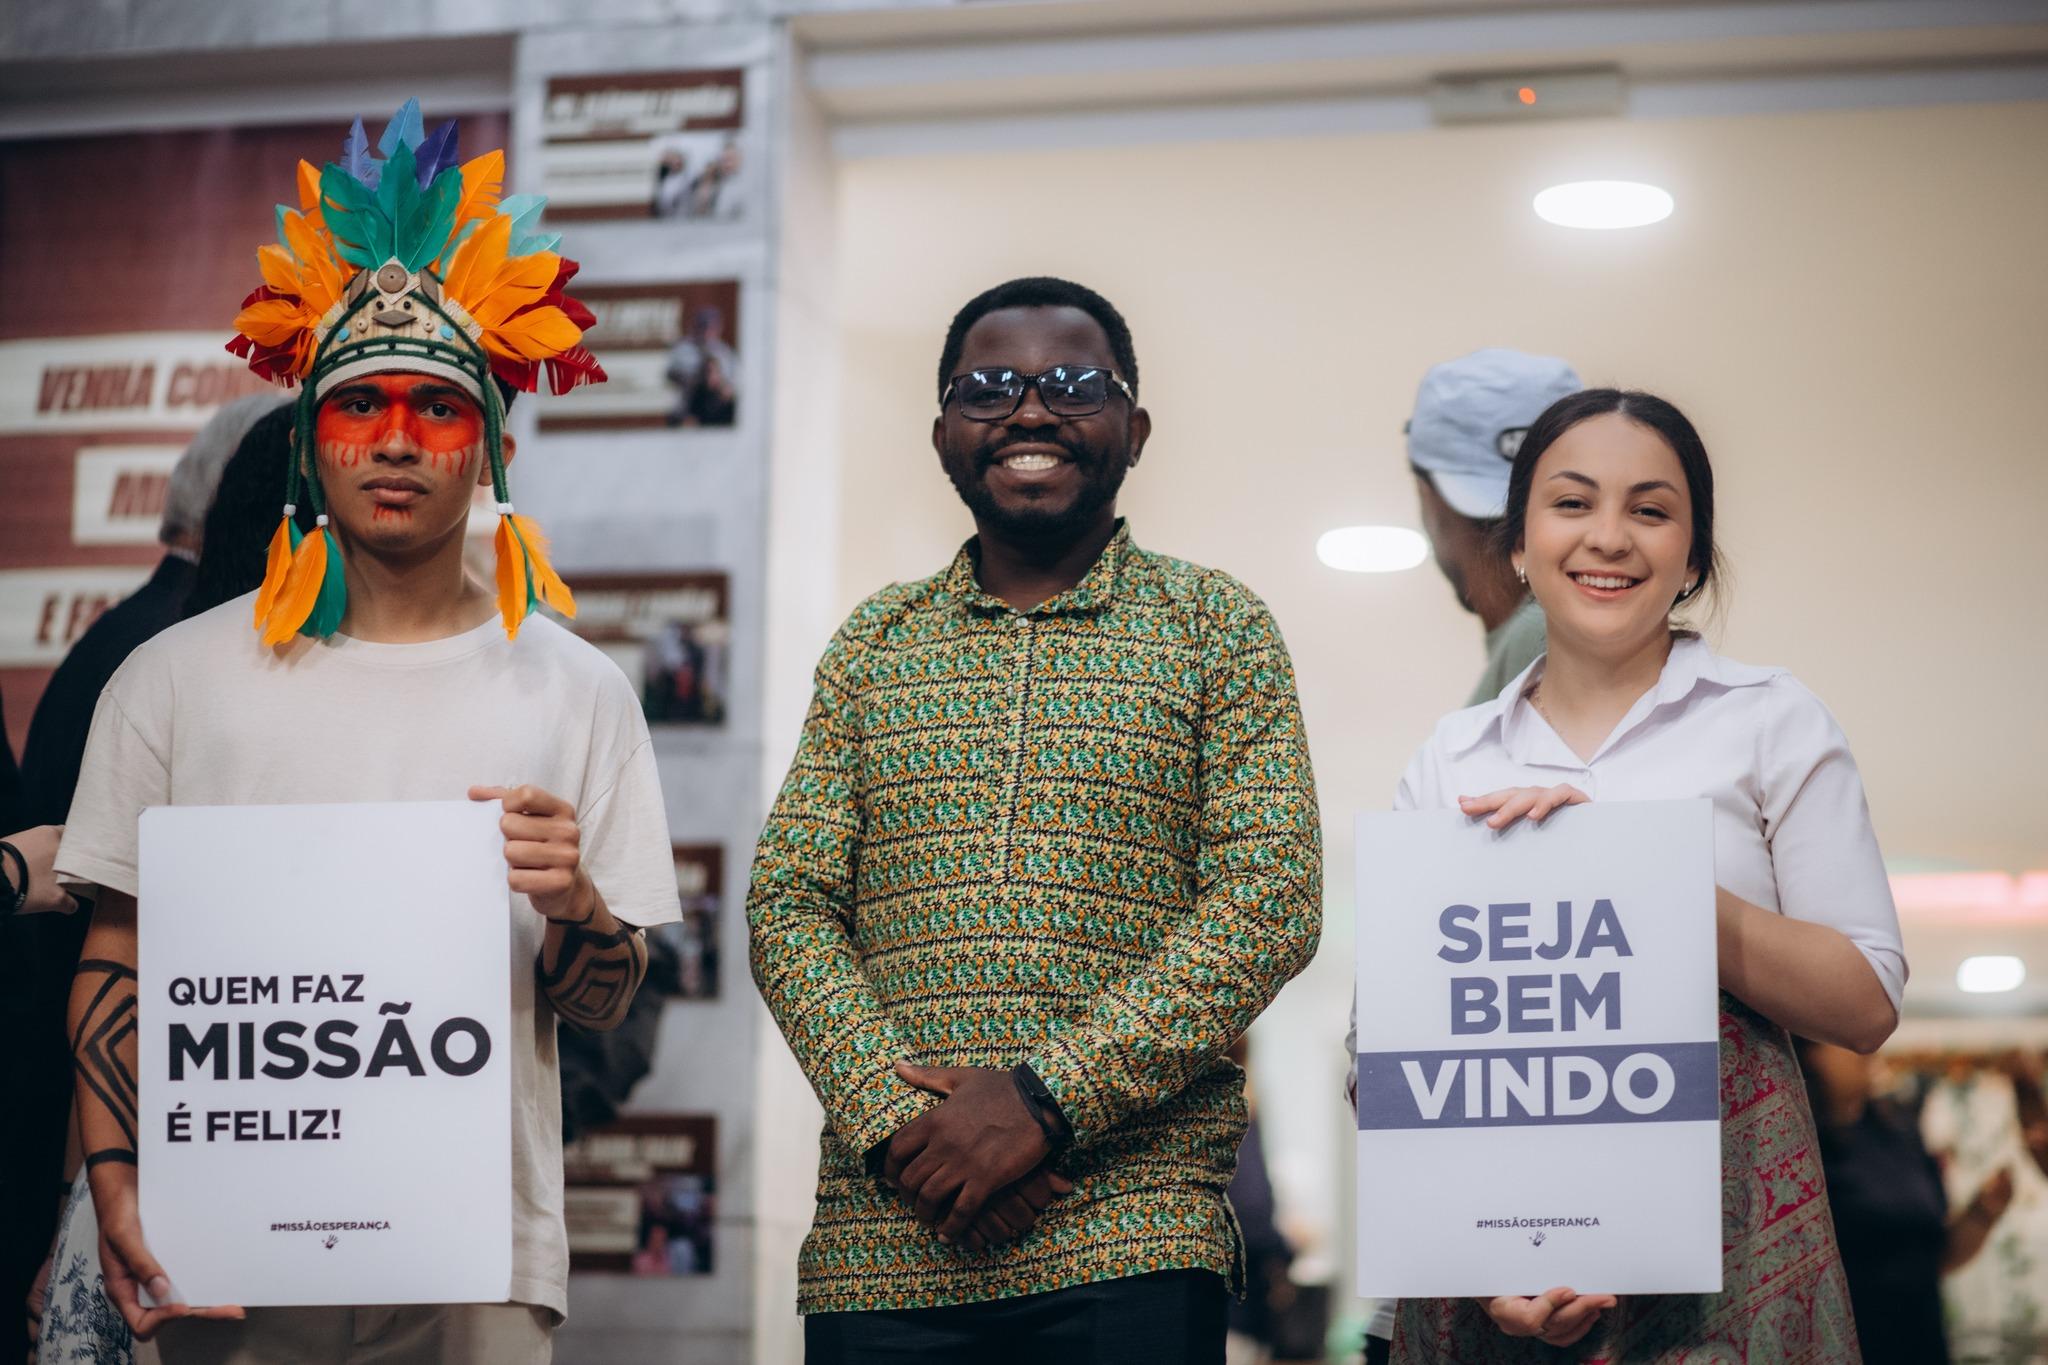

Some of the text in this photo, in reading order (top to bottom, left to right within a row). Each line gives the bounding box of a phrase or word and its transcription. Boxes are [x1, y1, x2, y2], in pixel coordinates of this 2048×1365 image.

[38, 362, 156, 413] VENHA
[1437, 898, 1634, 964] SEJA
[168, 974, 365, 1006] QUEM FAZ
[1450, 971, 1622, 1036] BEM
[168, 1001, 492, 1082] MISSÃO
[1400, 1052, 1676, 1120] VINDO
[167, 1102, 341, 1143] É FELIZ!
[270, 1220, 391, 1232] #MISSÃOESPERANÇA
[1476, 1216, 1601, 1229] #MISSÃOESPERANÇA
